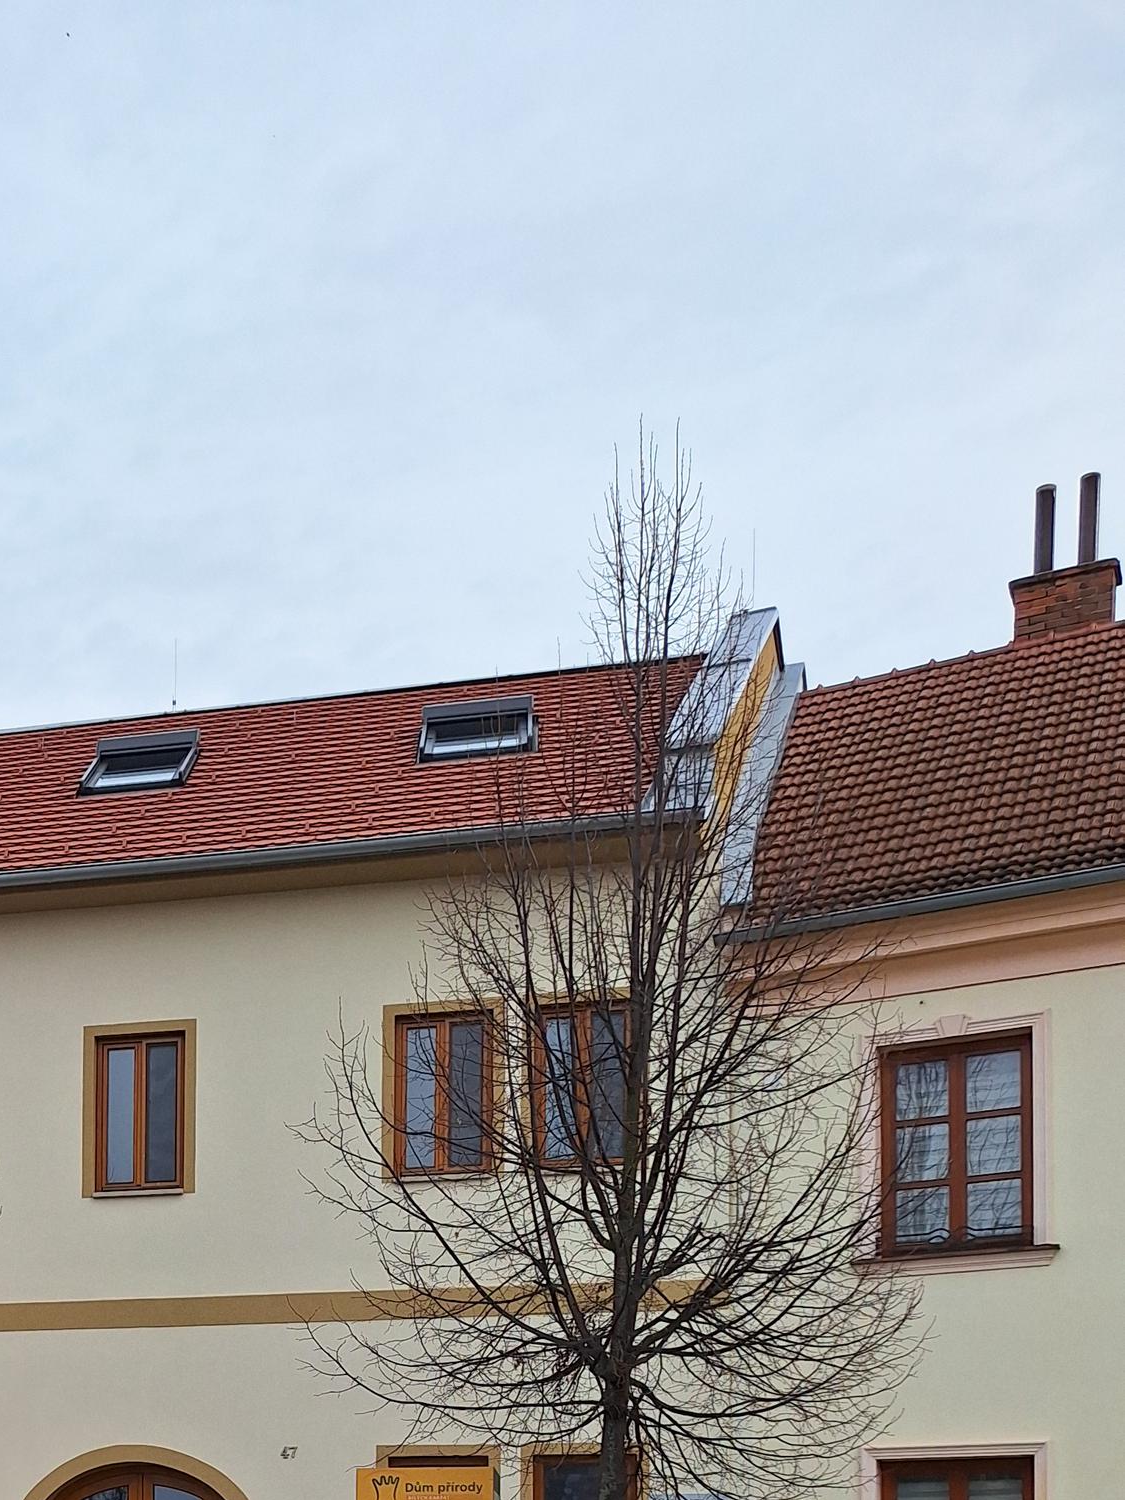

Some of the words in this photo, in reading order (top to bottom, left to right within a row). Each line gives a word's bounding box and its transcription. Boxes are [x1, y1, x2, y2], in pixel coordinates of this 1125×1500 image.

[280, 1446, 298, 1459] 47
[405, 1482, 434, 1493] Dům
[438, 1482, 483, 1495] přírody
